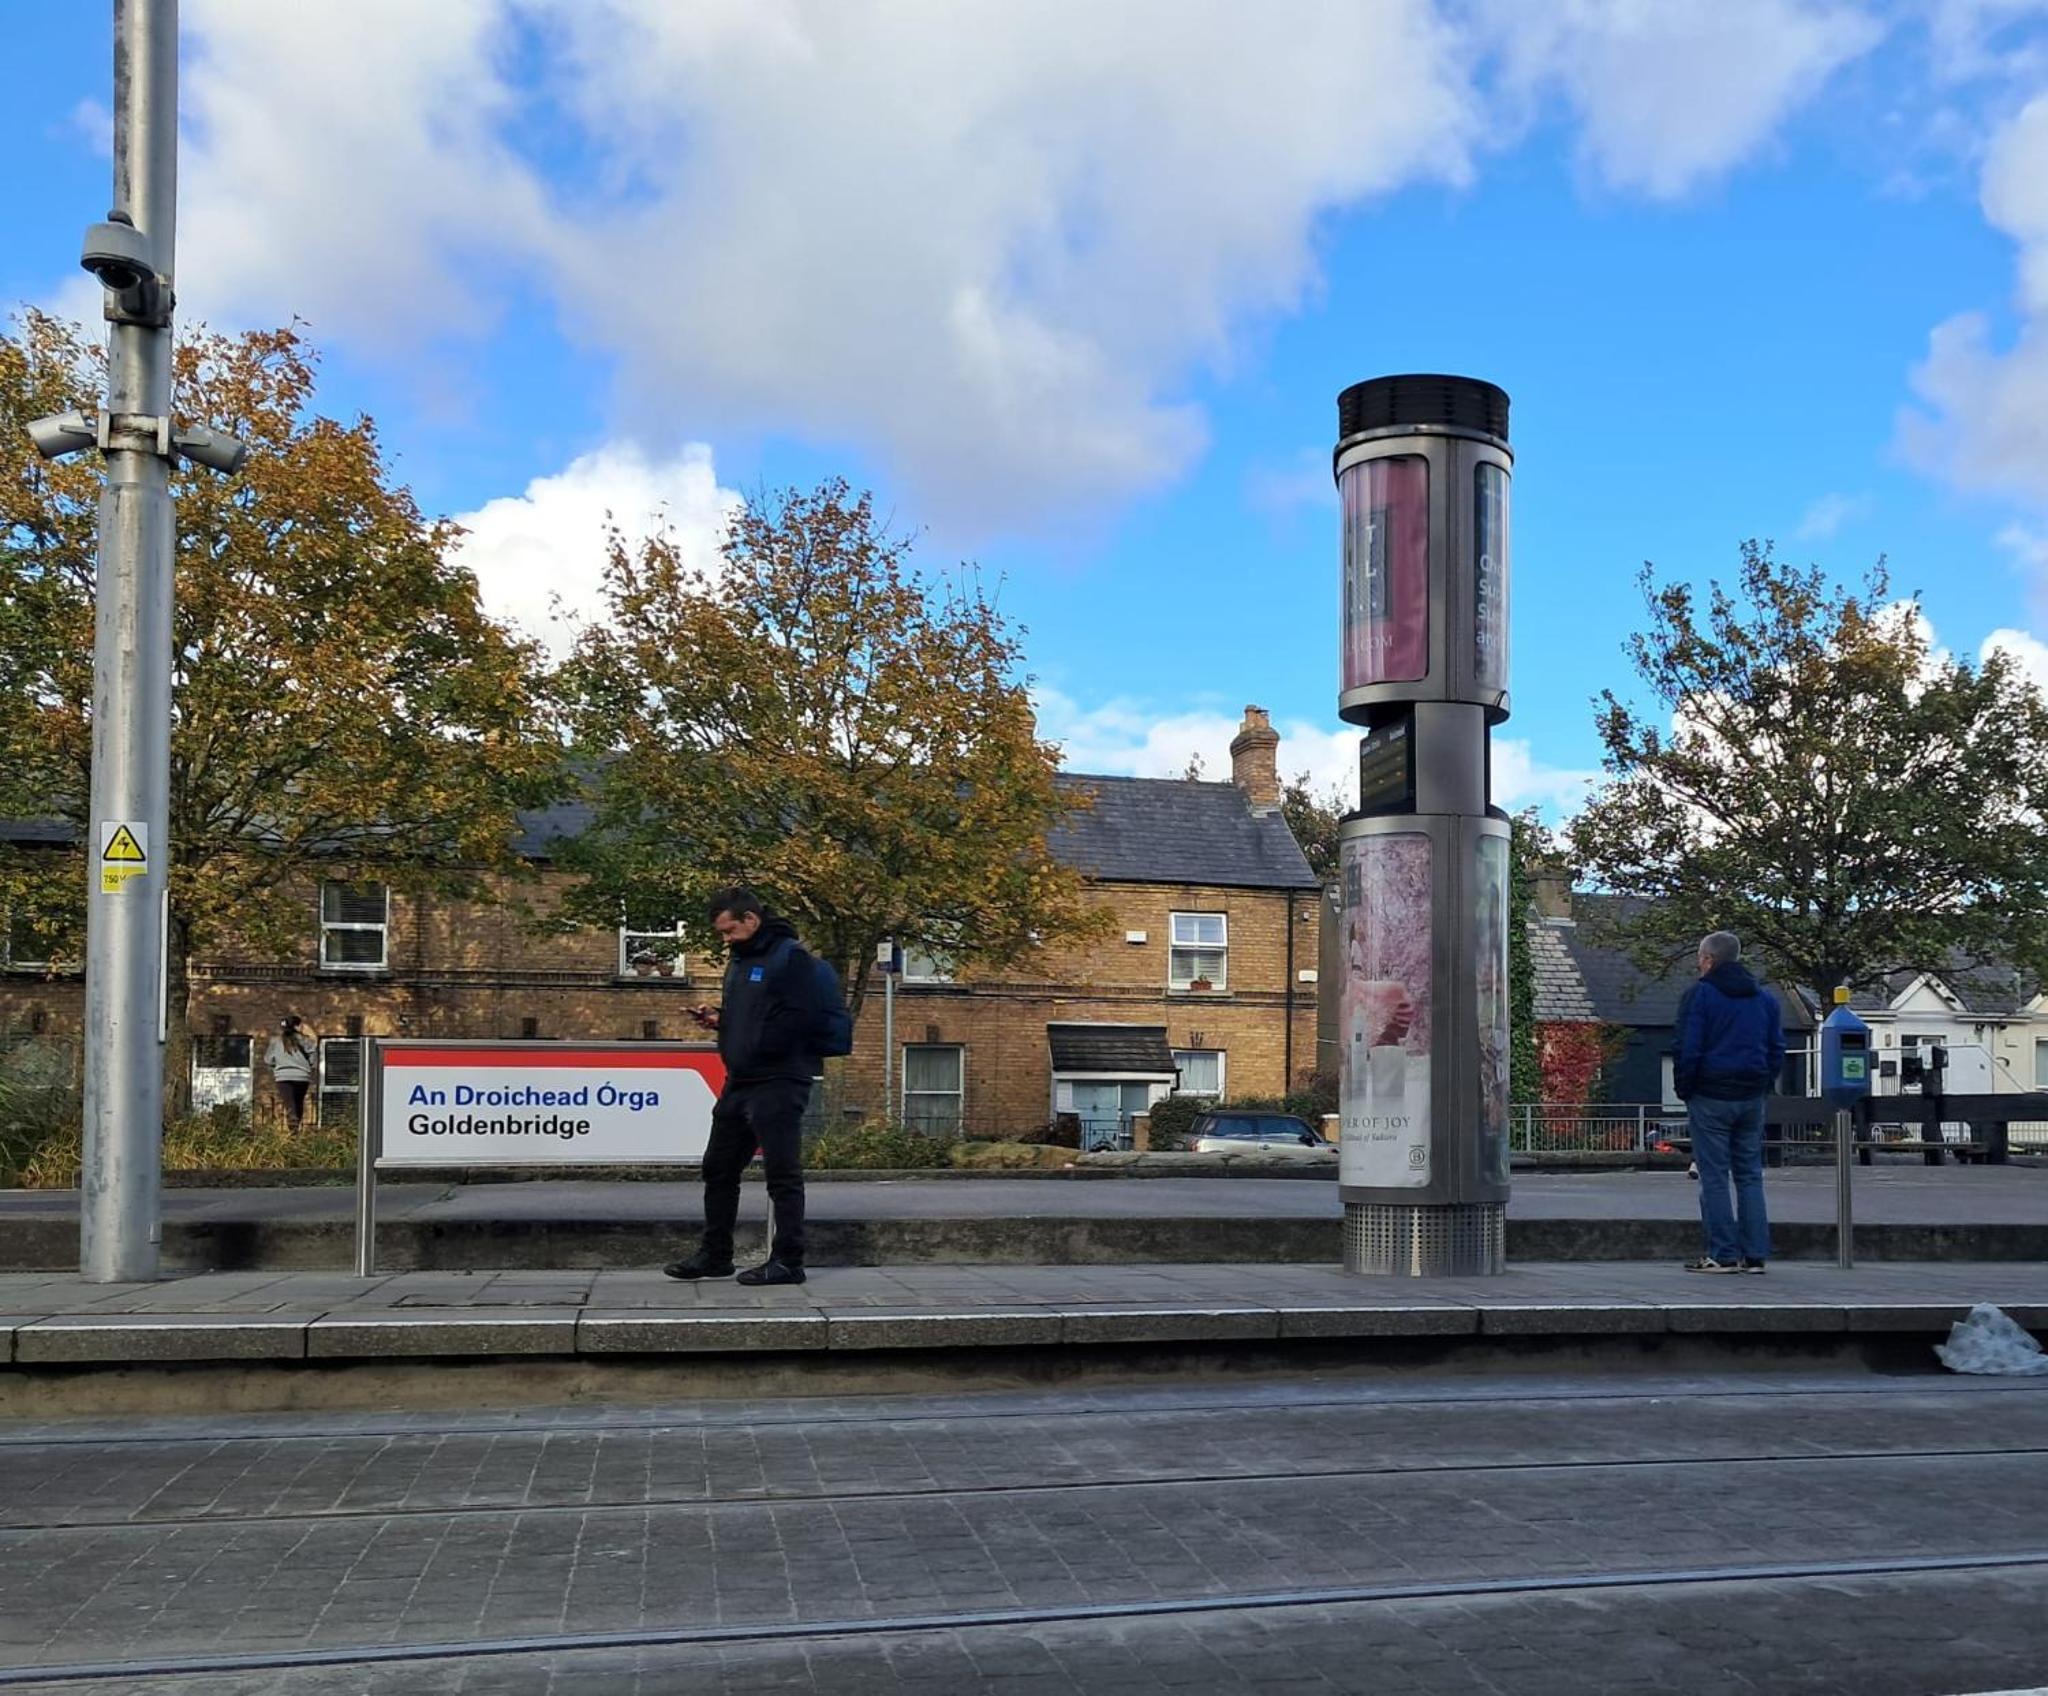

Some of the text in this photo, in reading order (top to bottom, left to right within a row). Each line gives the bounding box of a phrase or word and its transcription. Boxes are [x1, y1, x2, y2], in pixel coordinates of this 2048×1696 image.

[408, 1081, 660, 1112] An Droichead Órga
[408, 1113, 591, 1140] Goldenbridge
[1362, 1116, 1379, 1128] OF
[1385, 1116, 1410, 1129] JOY
